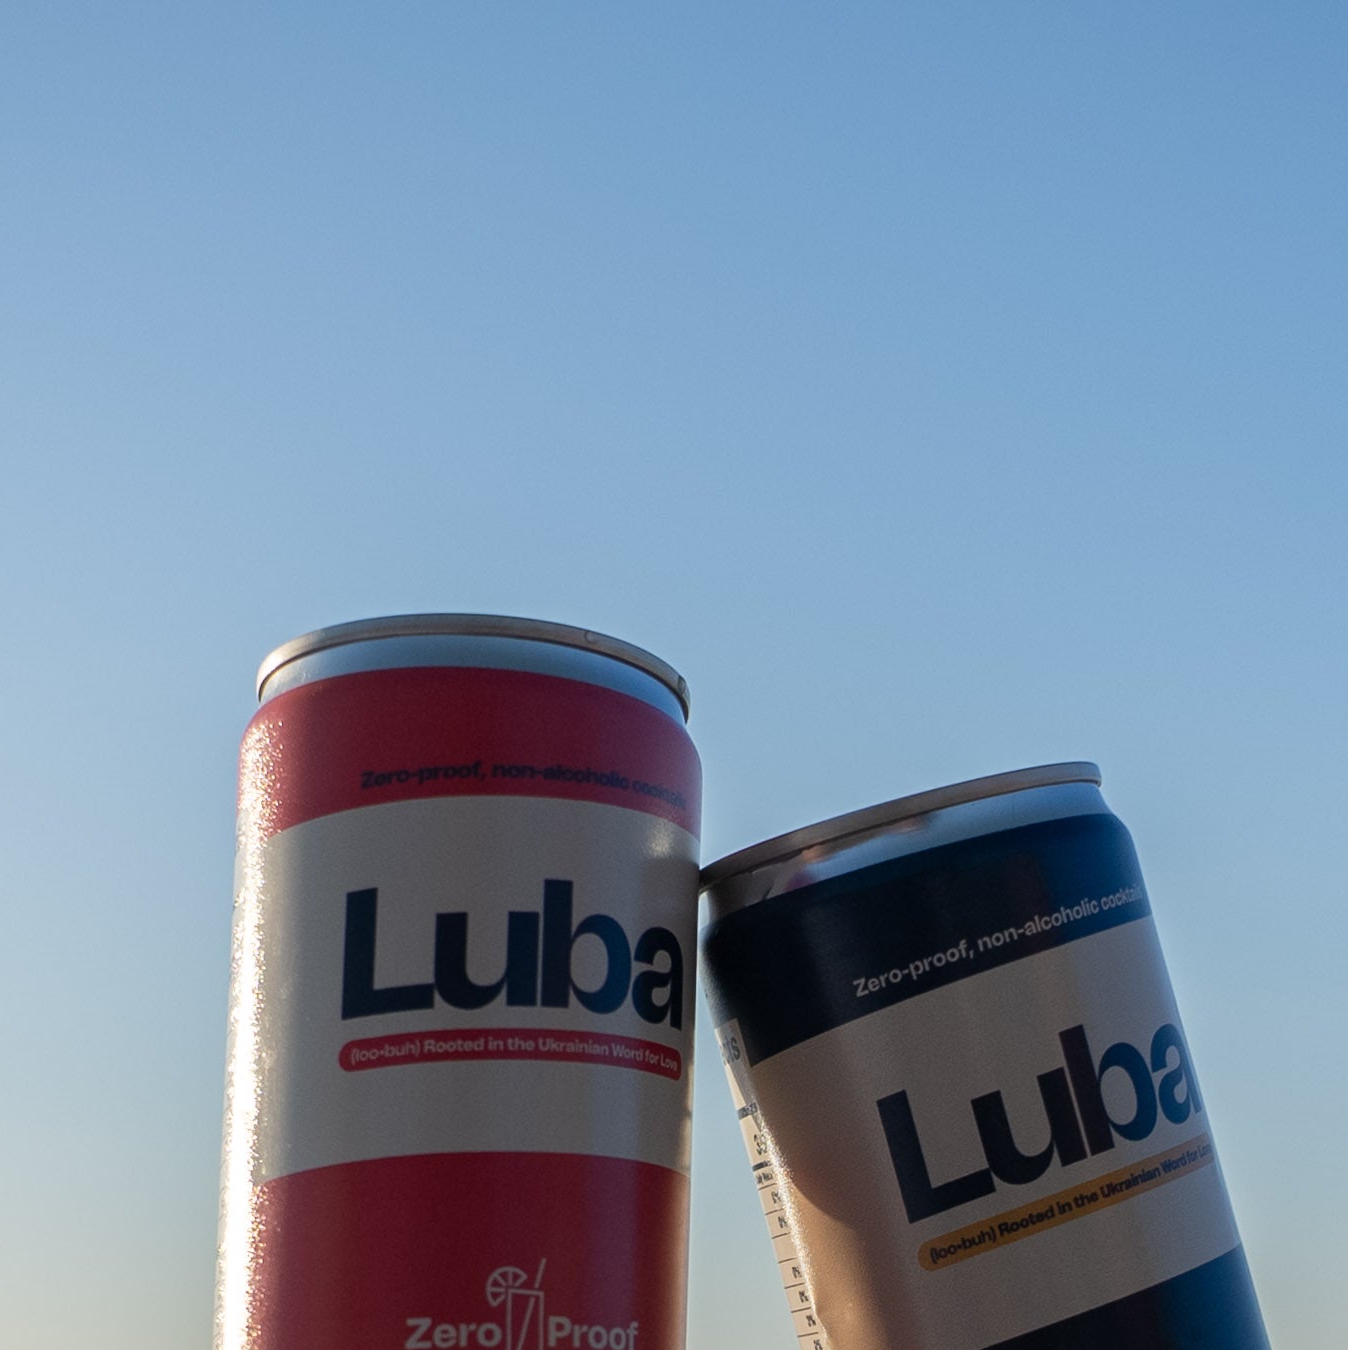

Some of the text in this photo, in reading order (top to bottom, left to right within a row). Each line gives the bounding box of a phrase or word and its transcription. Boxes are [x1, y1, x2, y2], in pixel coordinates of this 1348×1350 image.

[361, 760, 486, 790] Zero-proof,
[491, 763, 629, 790] non-alcoholic
[341, 878, 684, 1031] Luba
[853, 939, 975, 998] Zero-proof,
[978, 897, 1100, 953] non-alcoholic
[424, 1037, 483, 1054] Rooted
[488, 1037, 504, 1051] in
[507, 1037, 534, 1052] the
[538, 1037, 610, 1056] Ukrainian
[611, 1042, 644, 1062] Word
[644, 1047, 659, 1065] for
[875, 1023, 1203, 1224] Luba
[997, 1204, 1056, 1237] Rooted
[1057, 1199, 1073, 1216] in
[1072, 1188, 1100, 1210] the
[1100, 1167, 1162, 1199] Ukrainian
[1160, 1152, 1188, 1174] Word
[404, 1316, 503, 1350] Zero
